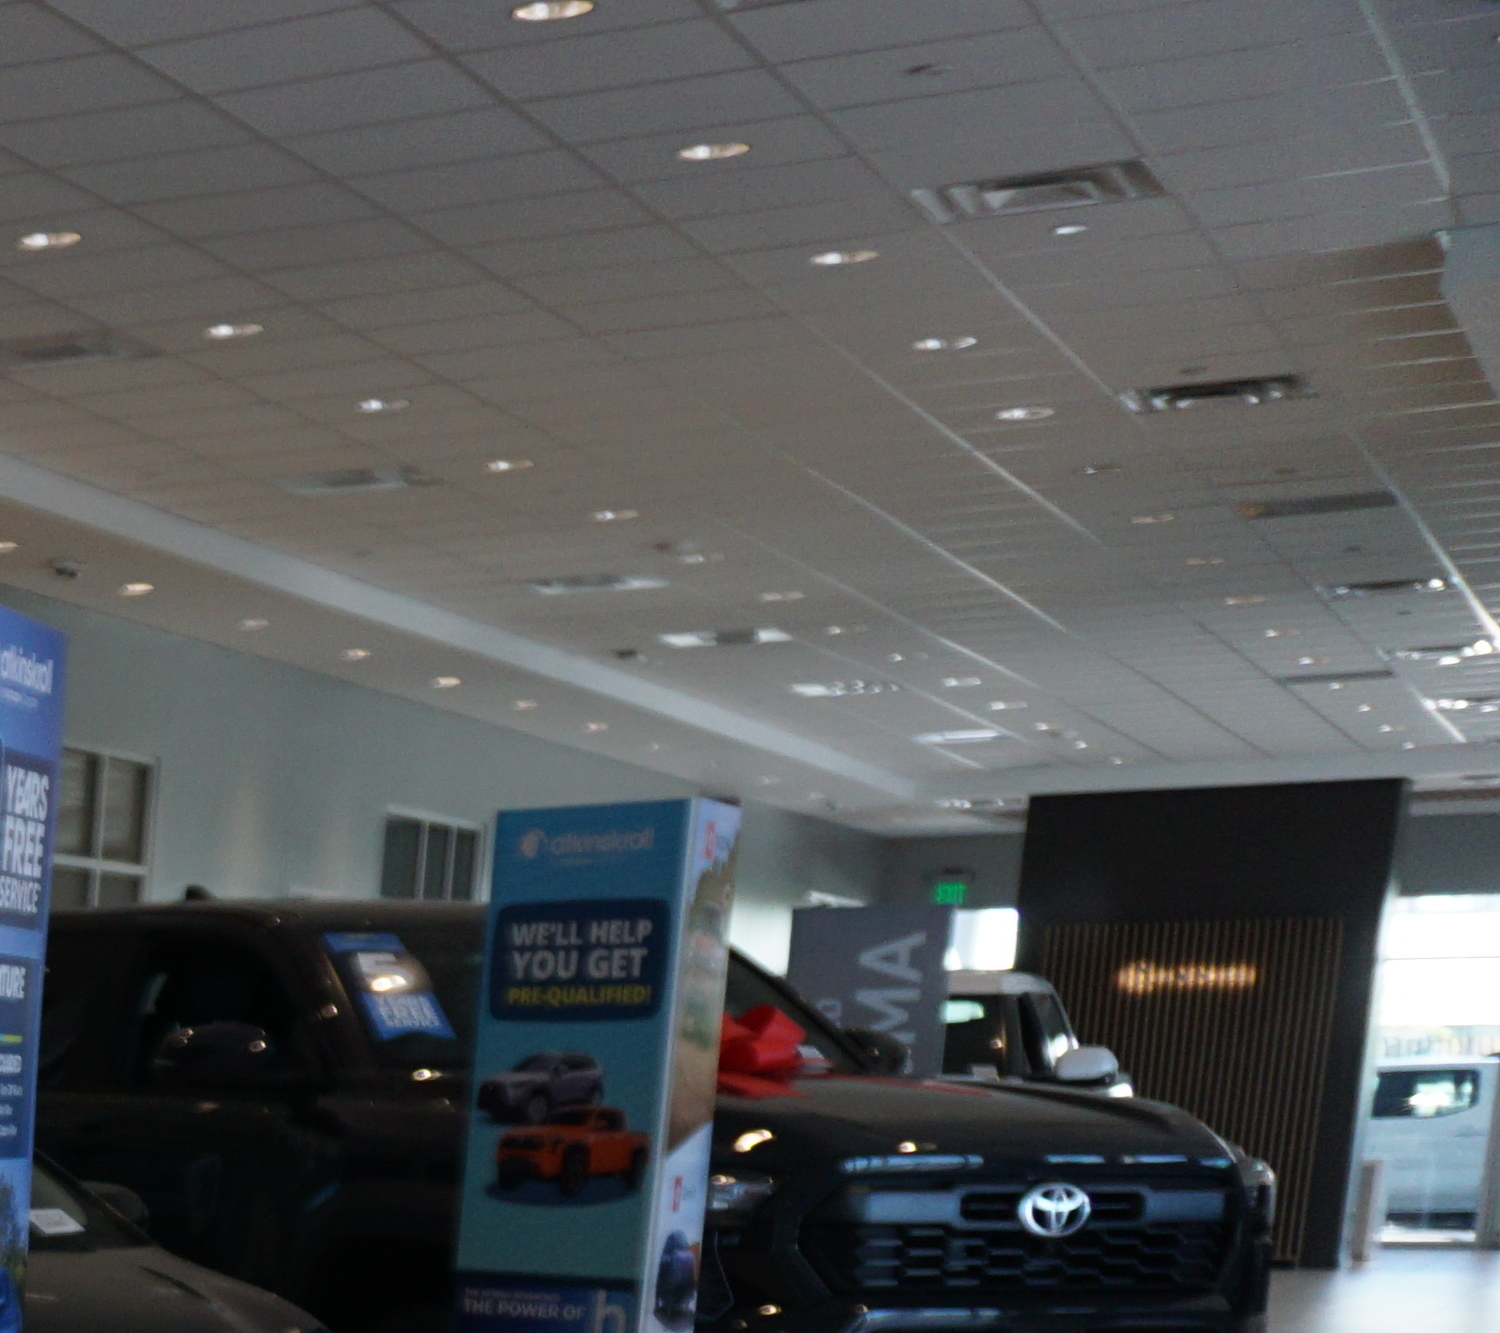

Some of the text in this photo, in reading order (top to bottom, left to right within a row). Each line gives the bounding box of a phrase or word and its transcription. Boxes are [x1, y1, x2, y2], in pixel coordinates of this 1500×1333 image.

[6, 764, 50, 821] YEARS
[3, 819, 46, 877] FREE
[511, 918, 654, 946] WE'LL HELP
[512, 947, 649, 981] YOU GET
[464, 1300, 492, 1313] THE
[498, 1301, 559, 1318] POWER
[563, 1306, 587, 1321] OF
